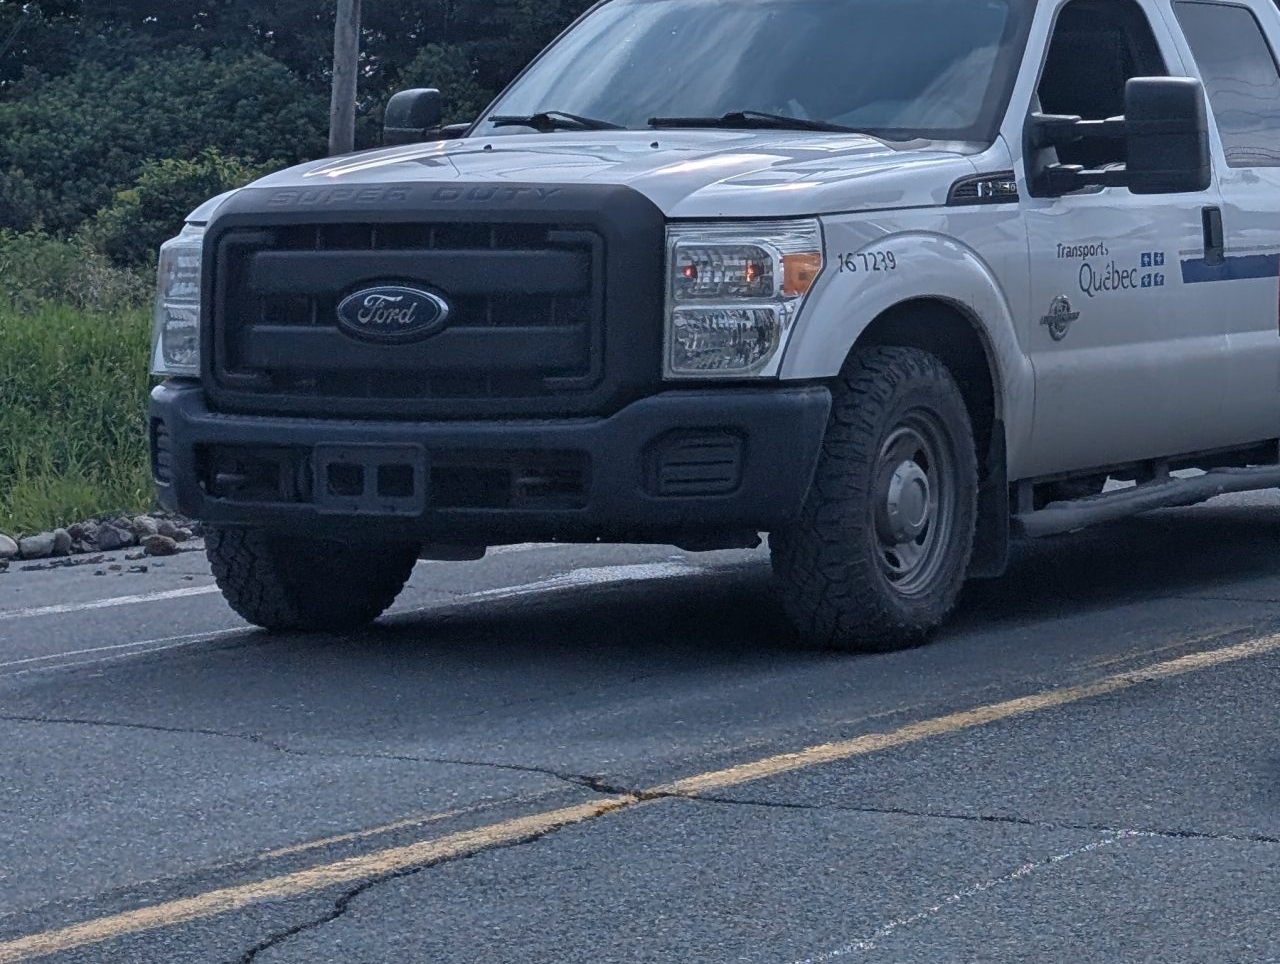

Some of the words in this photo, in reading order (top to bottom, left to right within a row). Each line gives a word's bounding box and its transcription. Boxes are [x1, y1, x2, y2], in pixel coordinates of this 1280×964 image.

[267, 187, 413, 207] SUPER
[430, 186, 565, 204] DUTY
[1079, 260, 1138, 297] Québec
[357, 293, 417, 326] Ford
